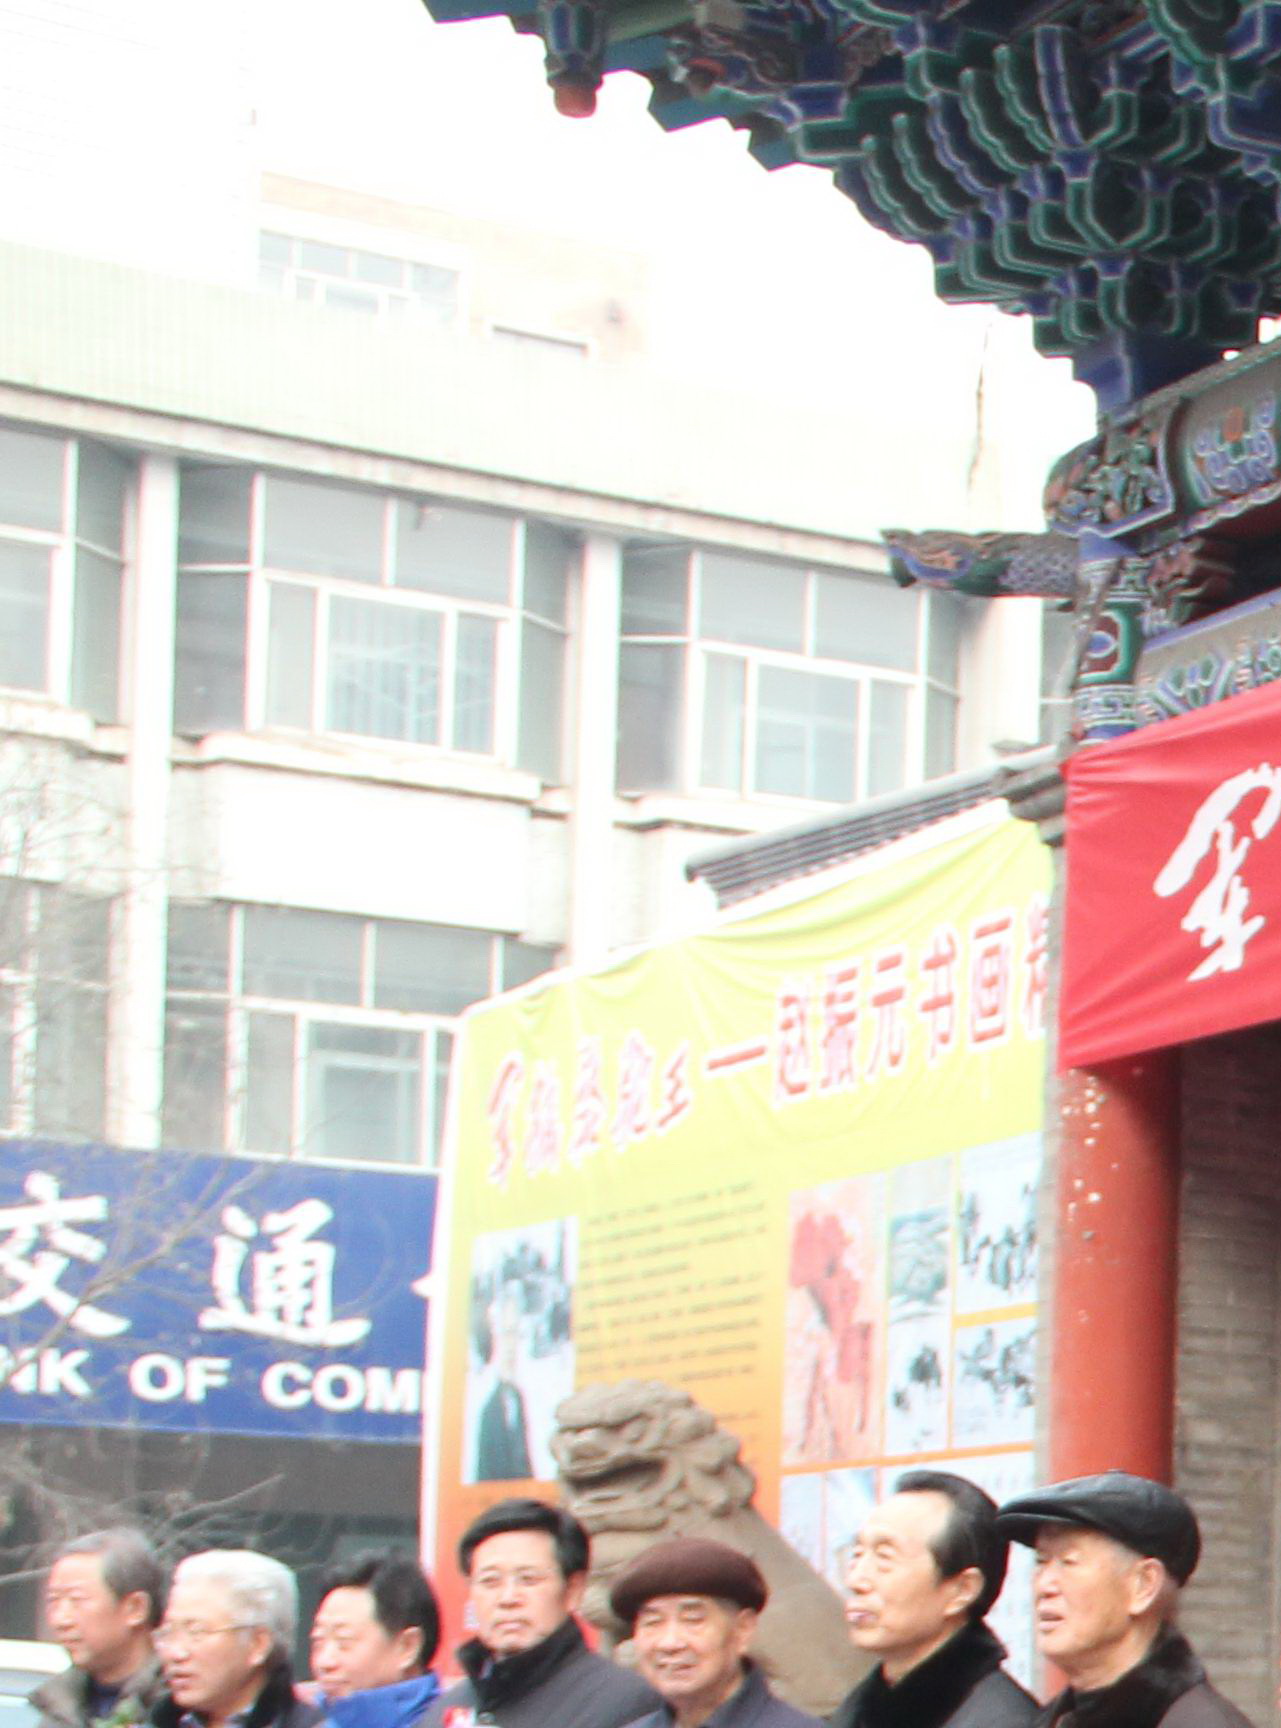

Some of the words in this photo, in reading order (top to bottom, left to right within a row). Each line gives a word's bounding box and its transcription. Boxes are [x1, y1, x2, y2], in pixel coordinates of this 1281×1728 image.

[0, 1170, 434, 1348] 交通
[0, 1344, 93, 1397] NK
[128, 1352, 231, 1402] OF
[260, 1361, 422, 1414] COM
